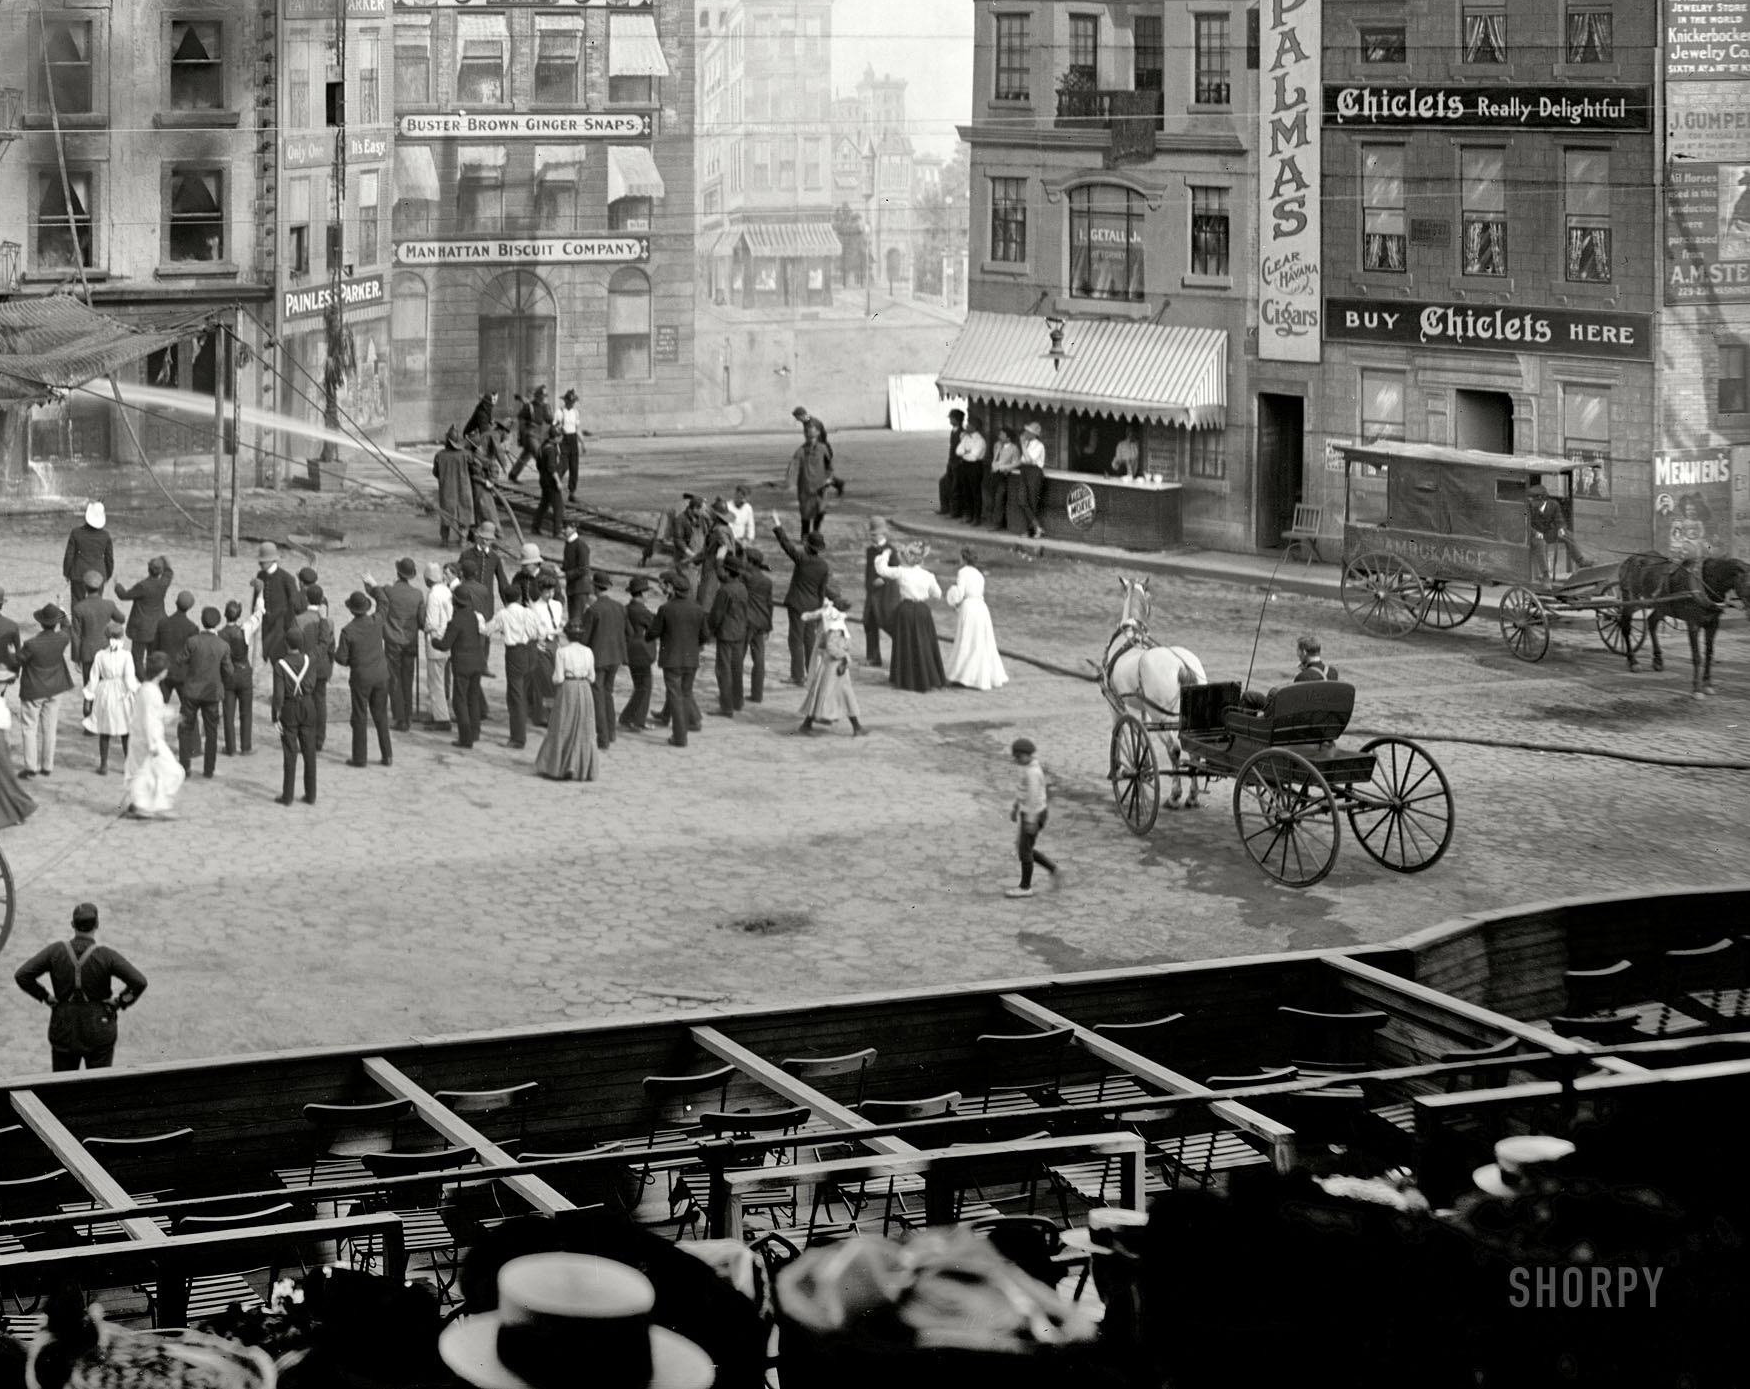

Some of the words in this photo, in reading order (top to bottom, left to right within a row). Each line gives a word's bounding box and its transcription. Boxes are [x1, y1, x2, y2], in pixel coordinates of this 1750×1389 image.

[1671, 2, 1714, 12] JEWELRY
[1716, 2, 1748, 12] STORE
[1677, 16, 1687, 24] IN
[1690, 16, 1706, 24] THE
[1709, 16, 1743, 24] WORLD
[1670, 44, 1726, 61] Jewelry
[1668, 64, 1695, 73] SIXTH
[1336, 87, 1464, 124] Chiclets
[1478, 96, 1532, 123] Really
[1539, 96, 1626, 124] Delightful
[406, 118, 460, 132] BUSTER
[467, 117, 519, 132] BROWN
[525, 117, 577, 131] GINGER
[584, 117, 640, 131] SNAPS.
[287, 144, 306, 163] Only
[1684, 173, 1717, 183] Horses
[1700, 189, 1717, 197] this
[1091, 229, 1126, 243] GETALL
[405, 243, 490, 259] MANHATTAN
[498, 243, 555, 258] BISCUIT
[562, 242, 638, 256] COMPANY.
[1261, 298, 1318, 337] Cigars
[1345, 310, 1400, 330] BUY
[1420, 305, 1552, 344] Chiclets
[1569, 323, 1635, 344] HERE
[1655, 452, 1730, 486] MENNEN'S
